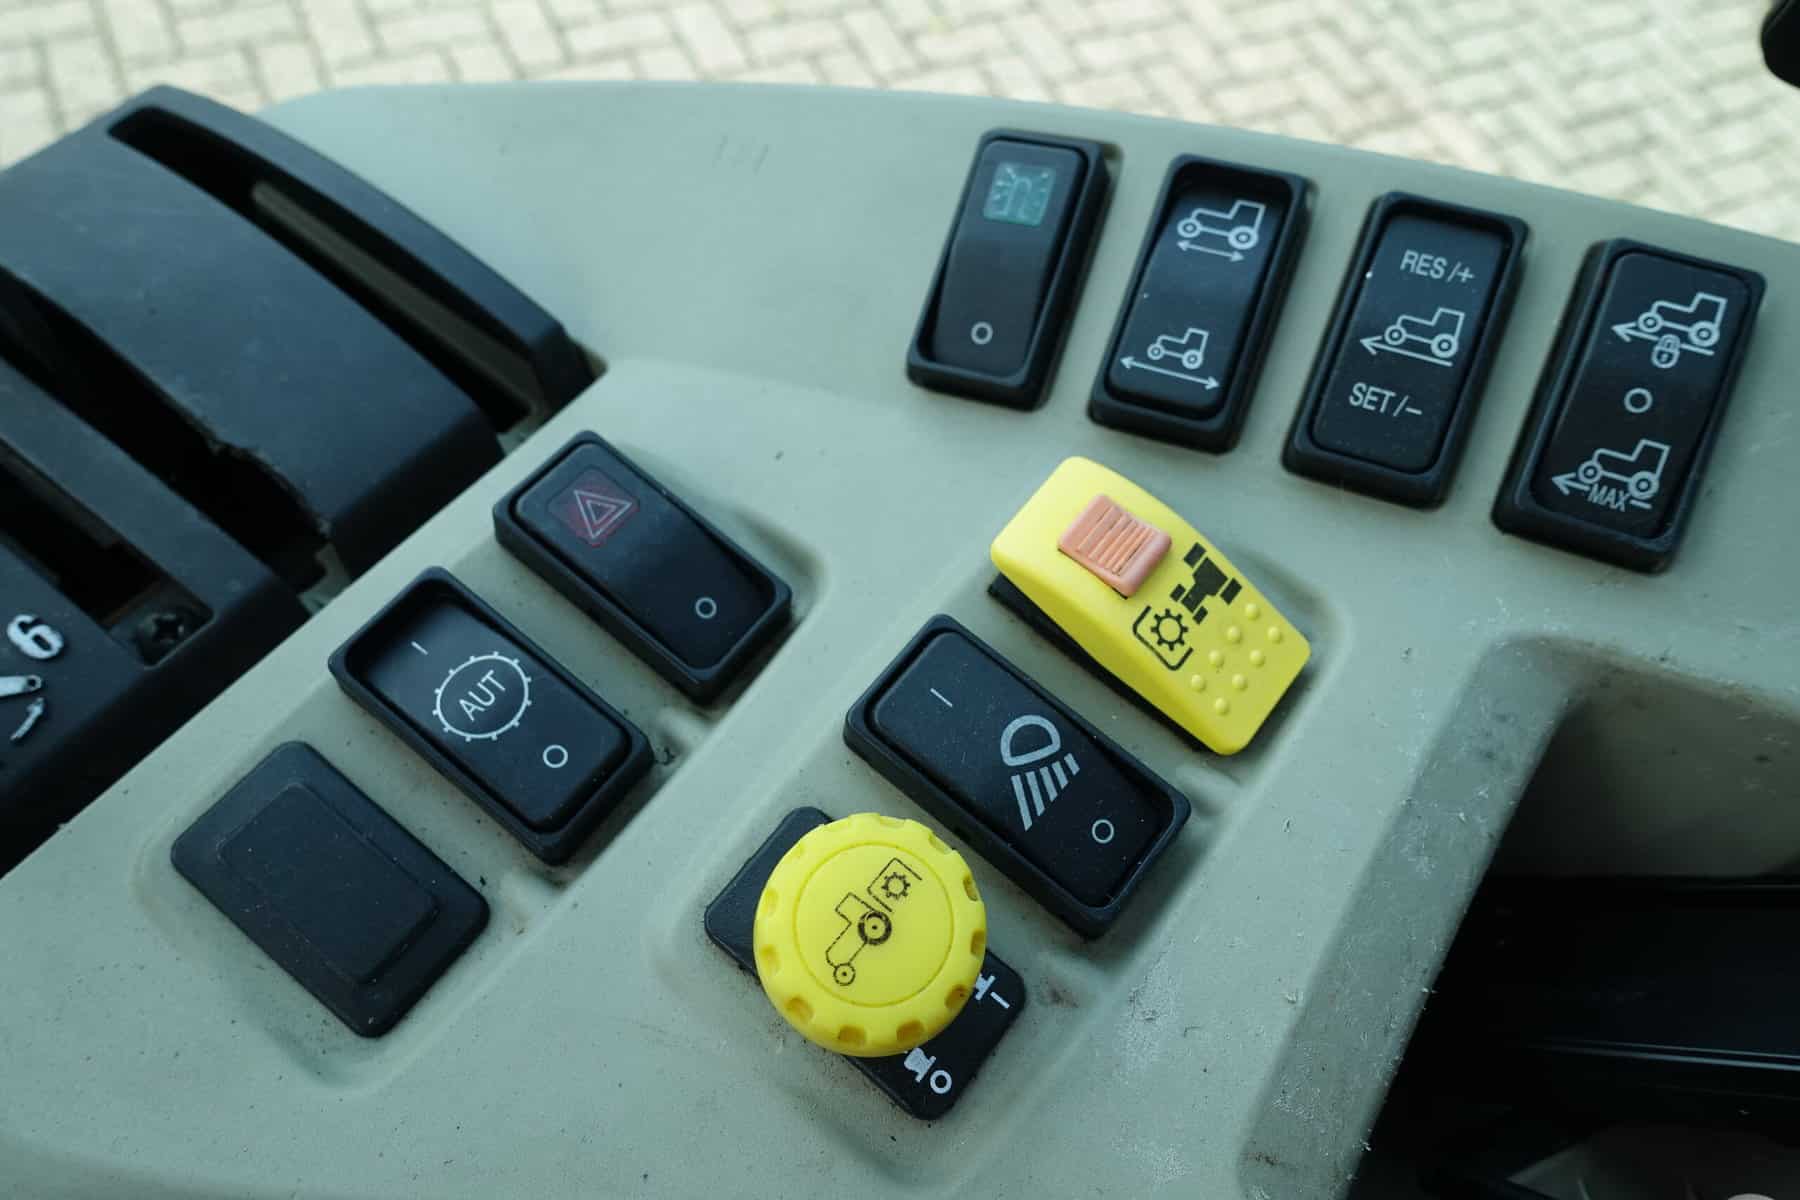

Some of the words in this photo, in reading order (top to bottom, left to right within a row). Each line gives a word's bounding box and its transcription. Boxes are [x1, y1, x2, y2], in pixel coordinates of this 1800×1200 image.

[1400, 249, 1448, 279] RES
[1349, 382, 1396, 413] SET
[1588, 483, 1632, 512] MAX
[7, 614, 65, 660] 6
[458, 669, 506, 722] AUT
